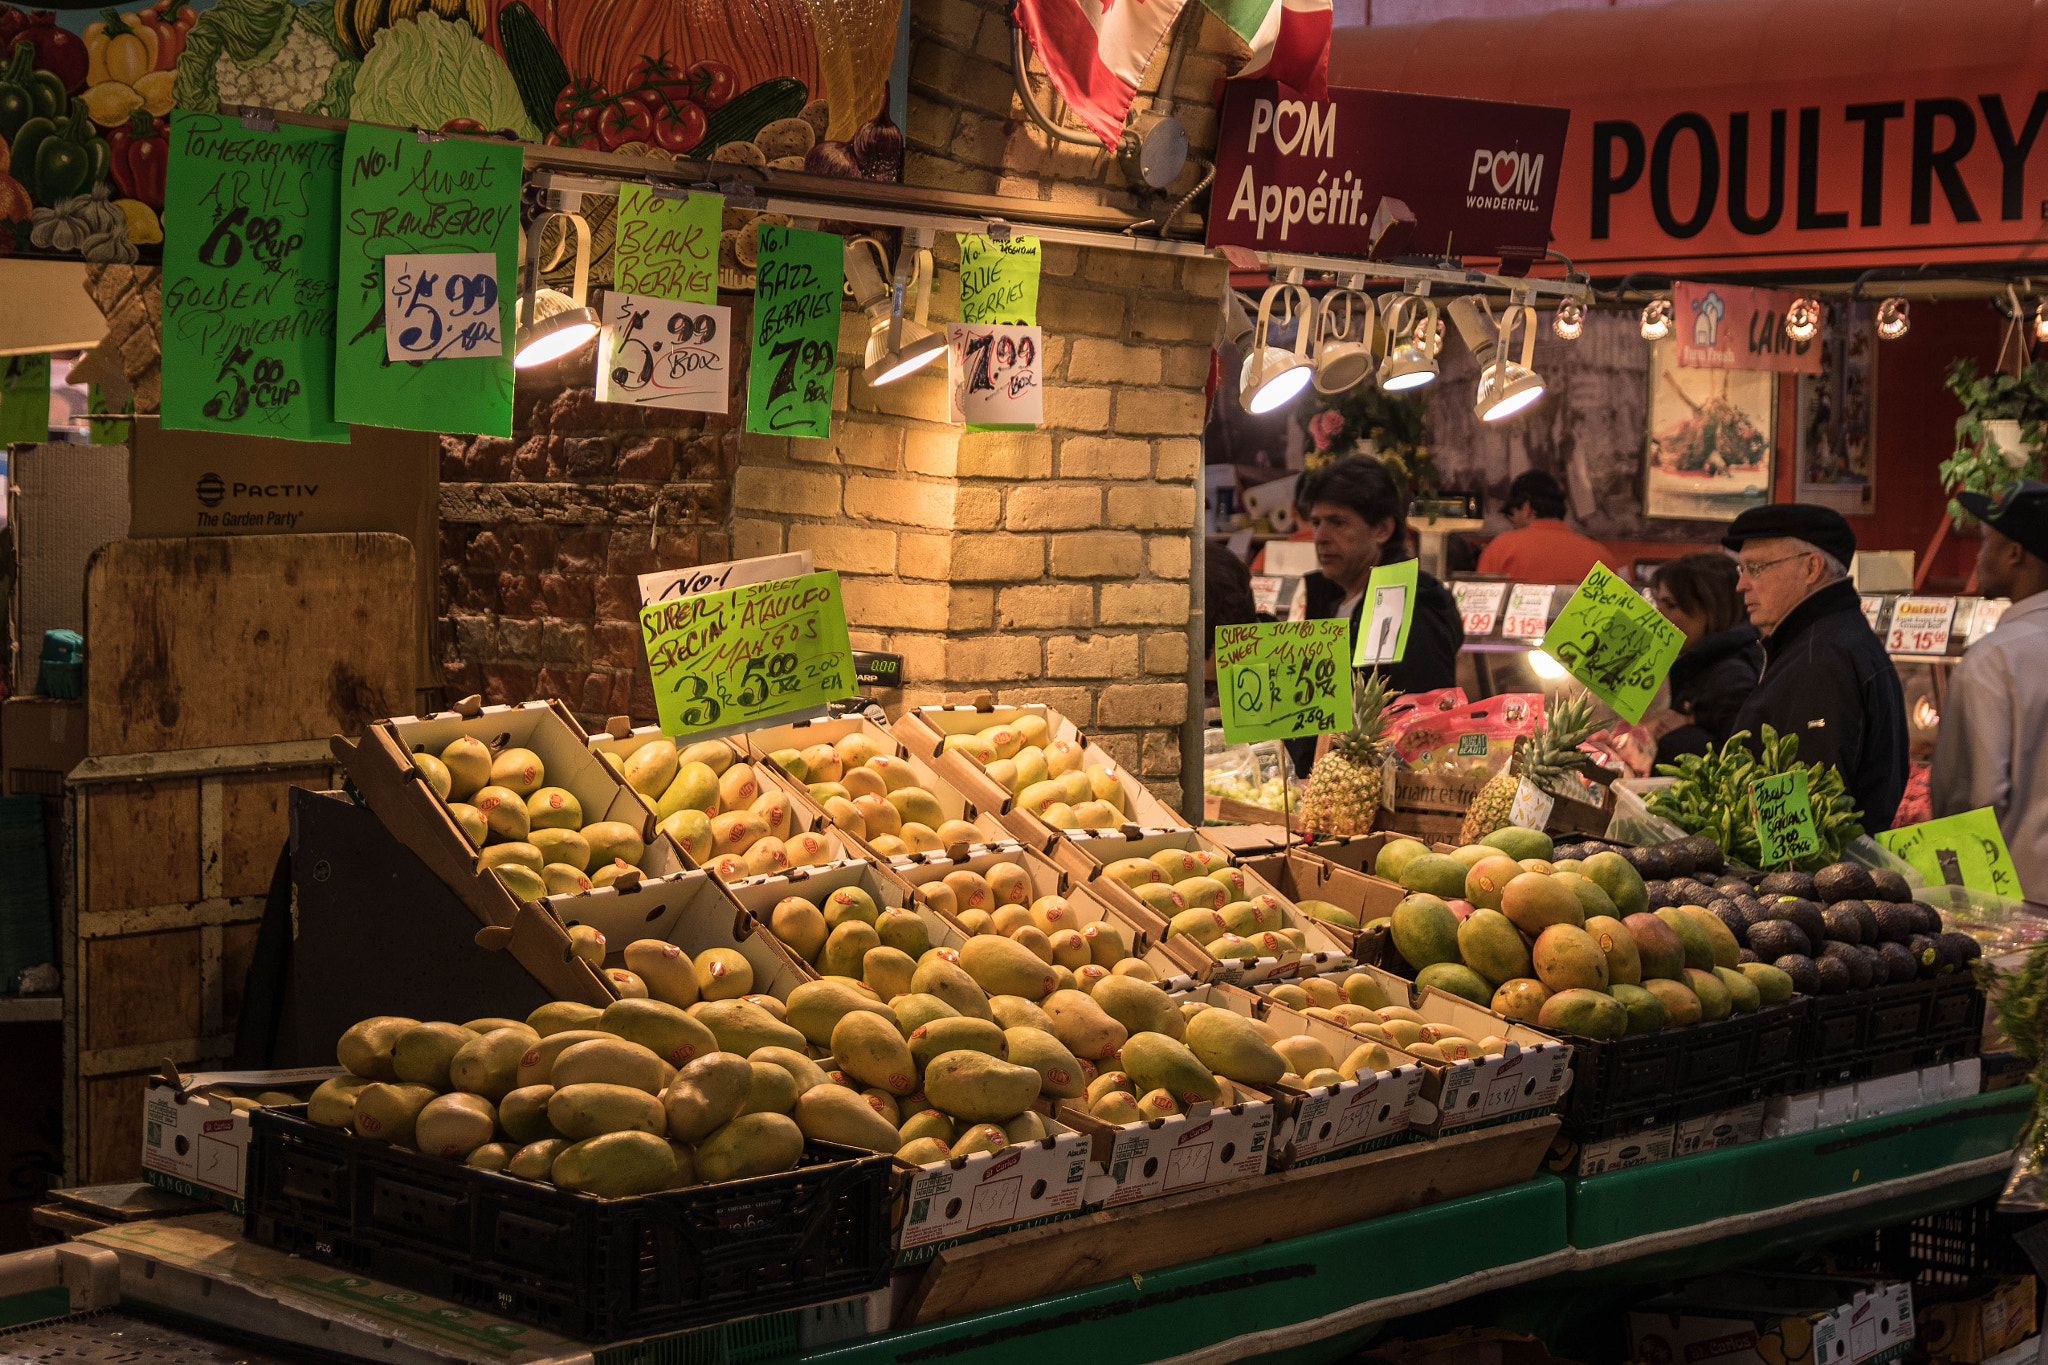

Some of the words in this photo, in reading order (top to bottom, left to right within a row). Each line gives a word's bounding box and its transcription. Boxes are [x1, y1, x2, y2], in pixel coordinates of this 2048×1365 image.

[1248, 98, 1337, 158] POM
[1468, 149, 1545, 196] POM
[1591, 90, 2048, 240] POULTRY
[1227, 165, 1368, 241] Appétit.
[961, 256, 1006, 301] BLUE
[232, 483, 319, 497] PACTIV
[197, 512, 219, 526] The
[222, 511, 264, 527] Garden
[746, 578, 802, 598] SWEET
[1588, 571, 1612, 587] ON
[1582, 586, 1634, 610] SPECIAL
[1899, 602, 1947, 616] Ontario
[1218, 626, 1263, 650] SUPER
[1890, 629, 1903, 650] 3
[1218, 637, 1260, 669] SWEET
[1265, 641, 1334, 664] MANGOS
[674, 671, 722, 726] 3
[1238, 667, 1263, 712] 2
[148, 1171, 192, 1197] MANGO
[1709, 1336, 1750, 1353] Carlos
